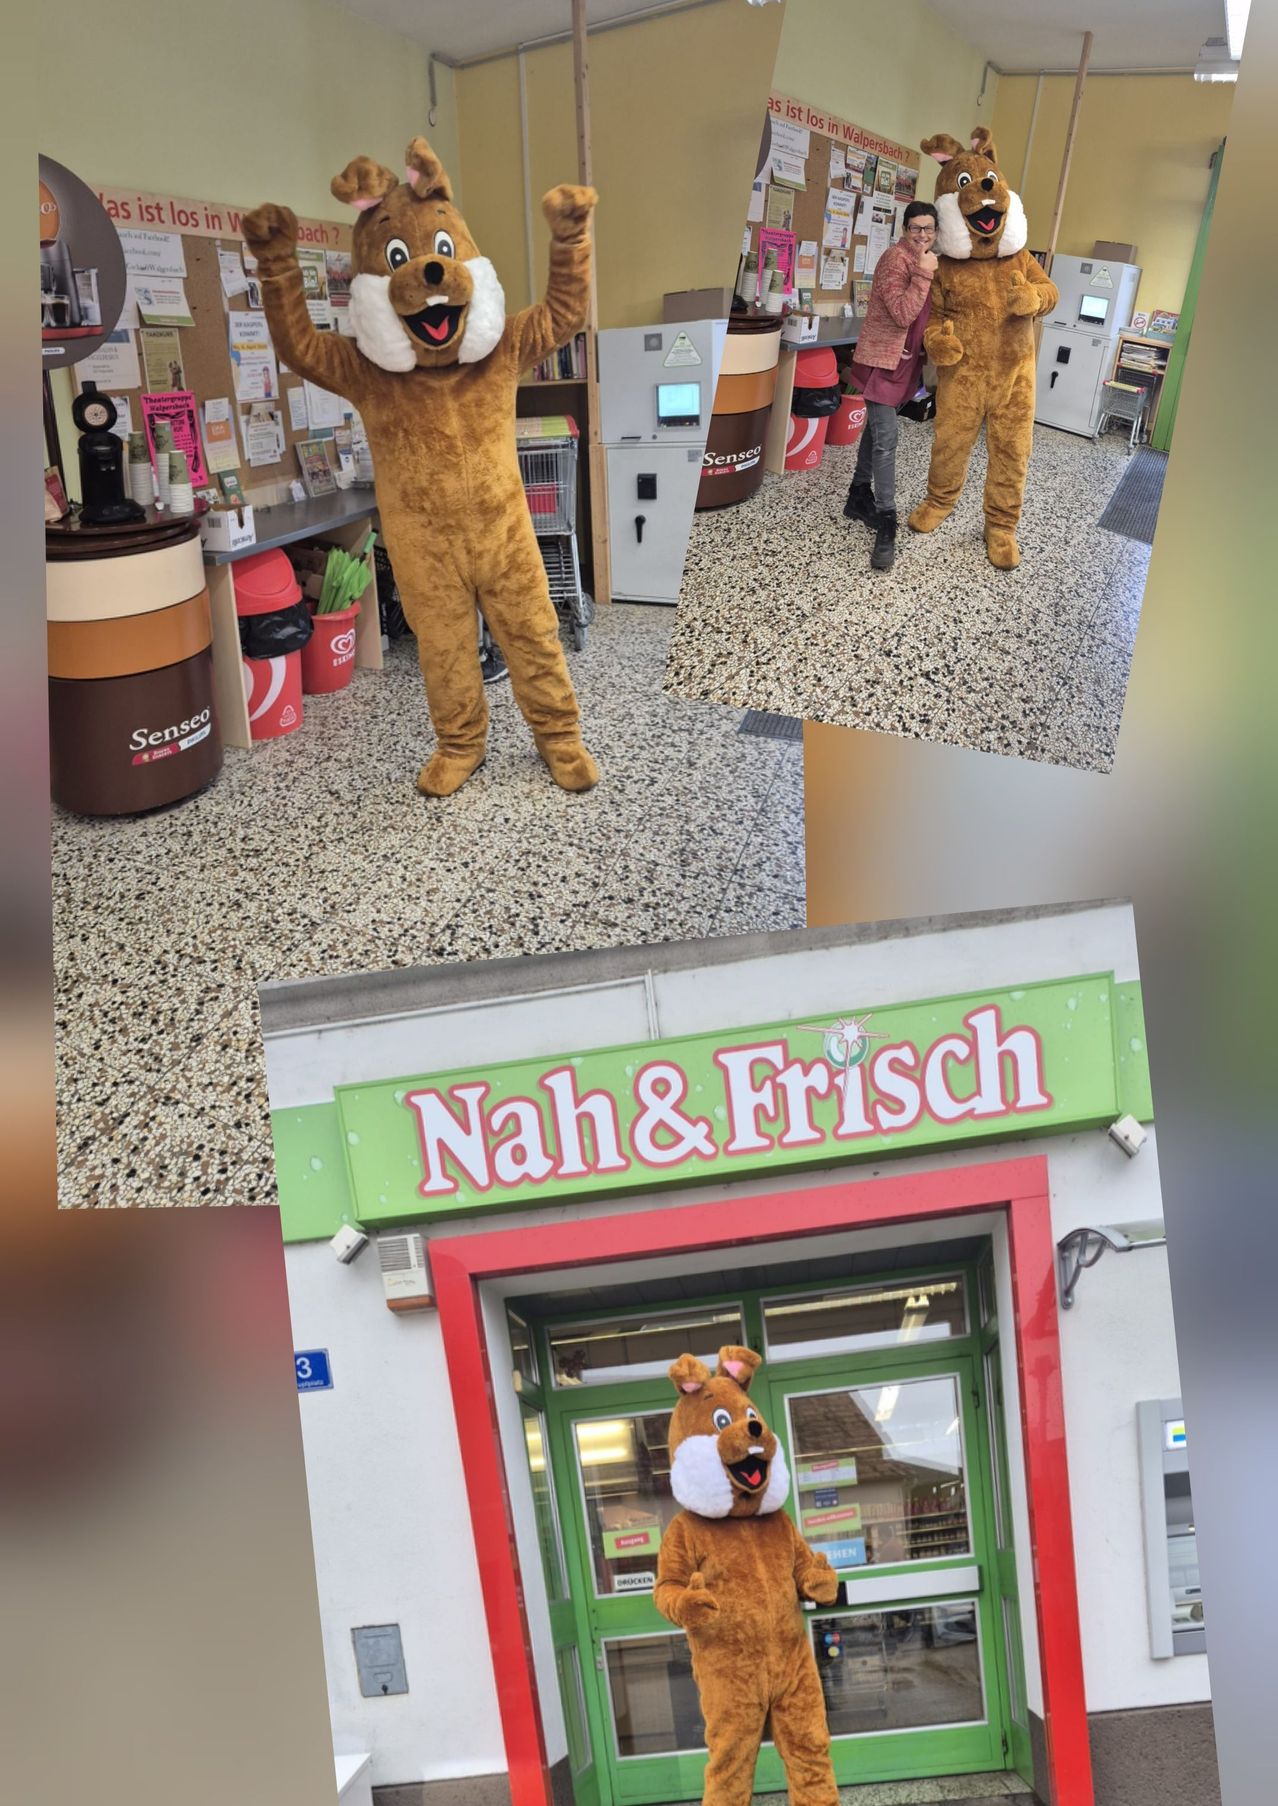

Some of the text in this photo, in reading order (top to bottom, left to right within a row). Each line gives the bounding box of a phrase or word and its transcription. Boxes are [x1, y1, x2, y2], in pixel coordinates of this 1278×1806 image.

[786, 100, 803, 122] ist
[806, 107, 825, 130] los
[827, 117, 839, 135] in
[842, 123, 903, 161] Walpersbach
[98, 192, 131, 220] as
[137, 197, 166, 225] ist
[169, 201, 199, 228] los
[204, 206, 222, 231] in
[702, 446, 761, 467] Senseo
[129, 708, 210, 751] Senseo
[296, 1357, 313, 1379] 3
[826, 1547, 857, 1560] EHEN
[616, 1575, 653, 1588] DRÜCKEN
